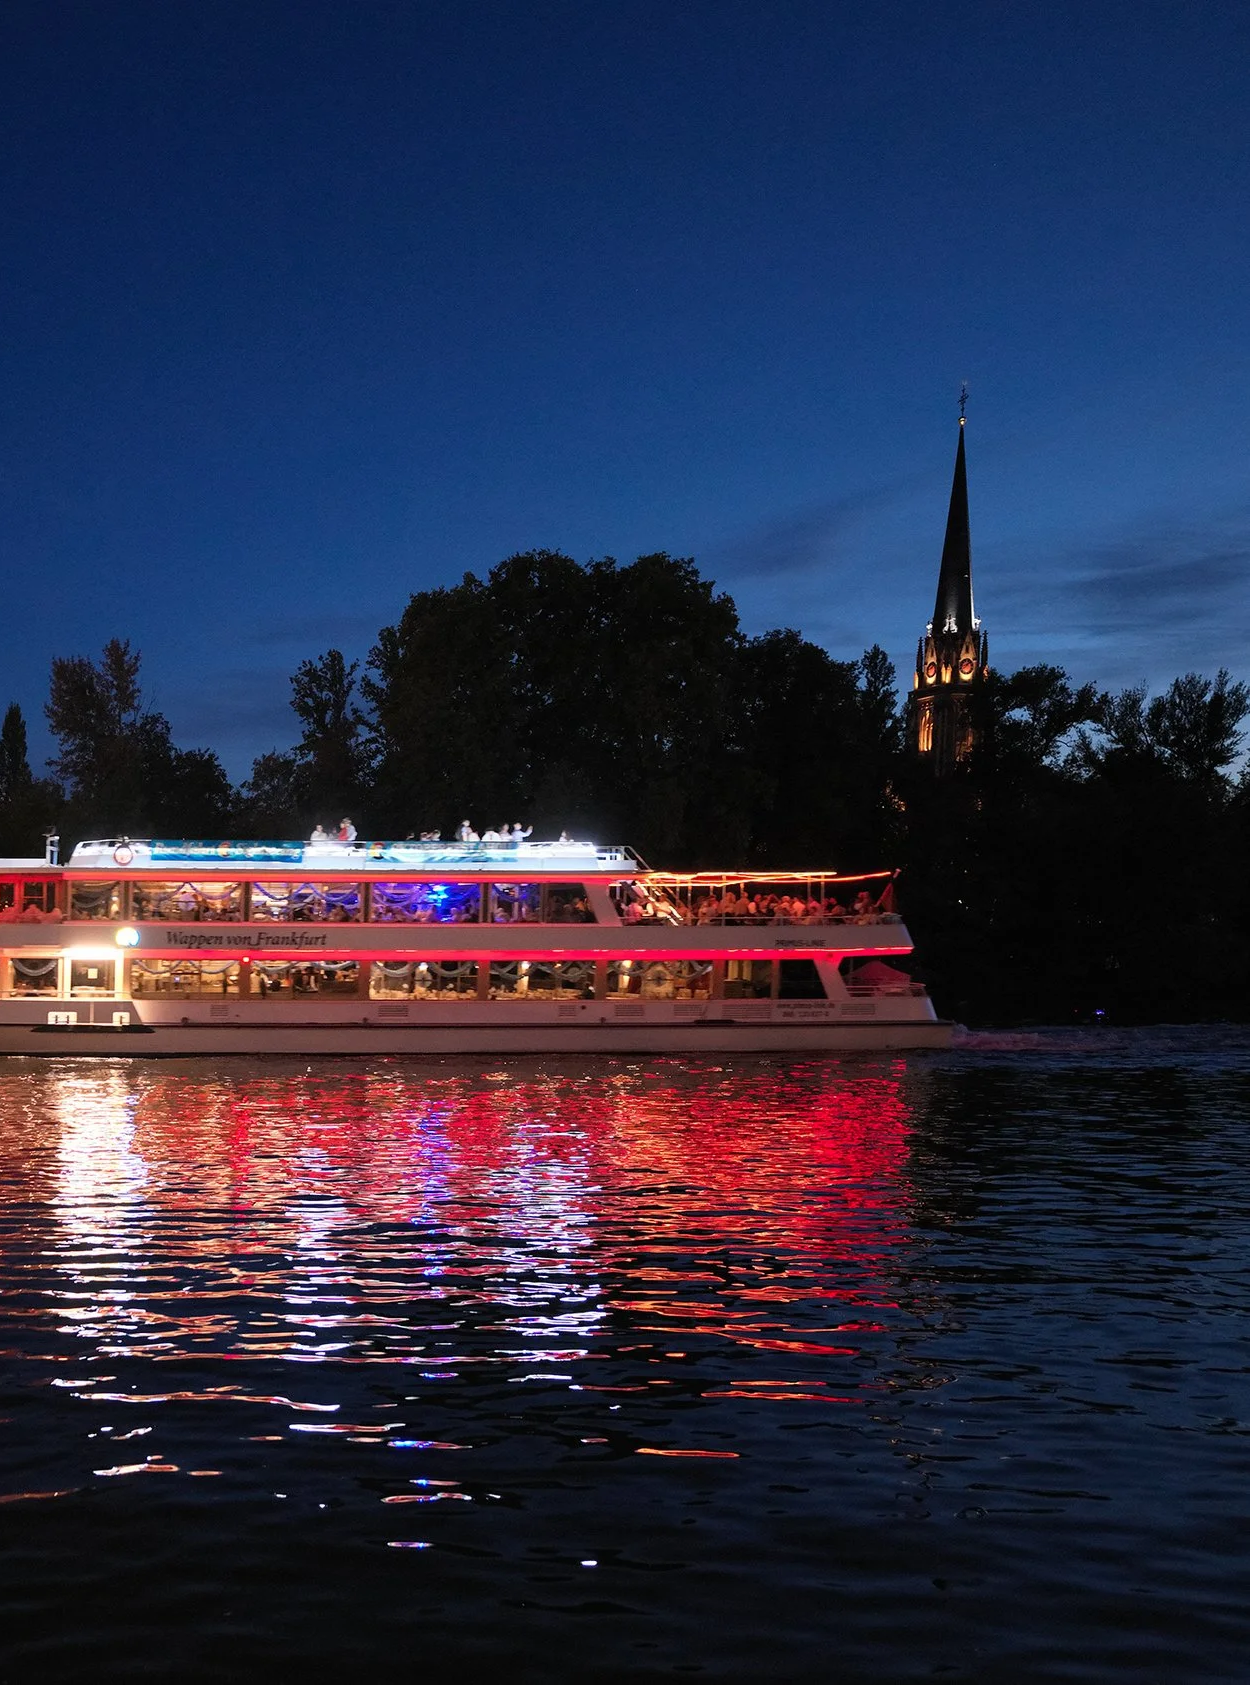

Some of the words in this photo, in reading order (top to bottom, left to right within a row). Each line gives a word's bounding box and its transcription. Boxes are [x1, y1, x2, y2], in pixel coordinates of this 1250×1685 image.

[166, 931, 223, 949] Wappen
[226, 934, 252, 946] von
[250, 931, 327, 948] Frankfurt
